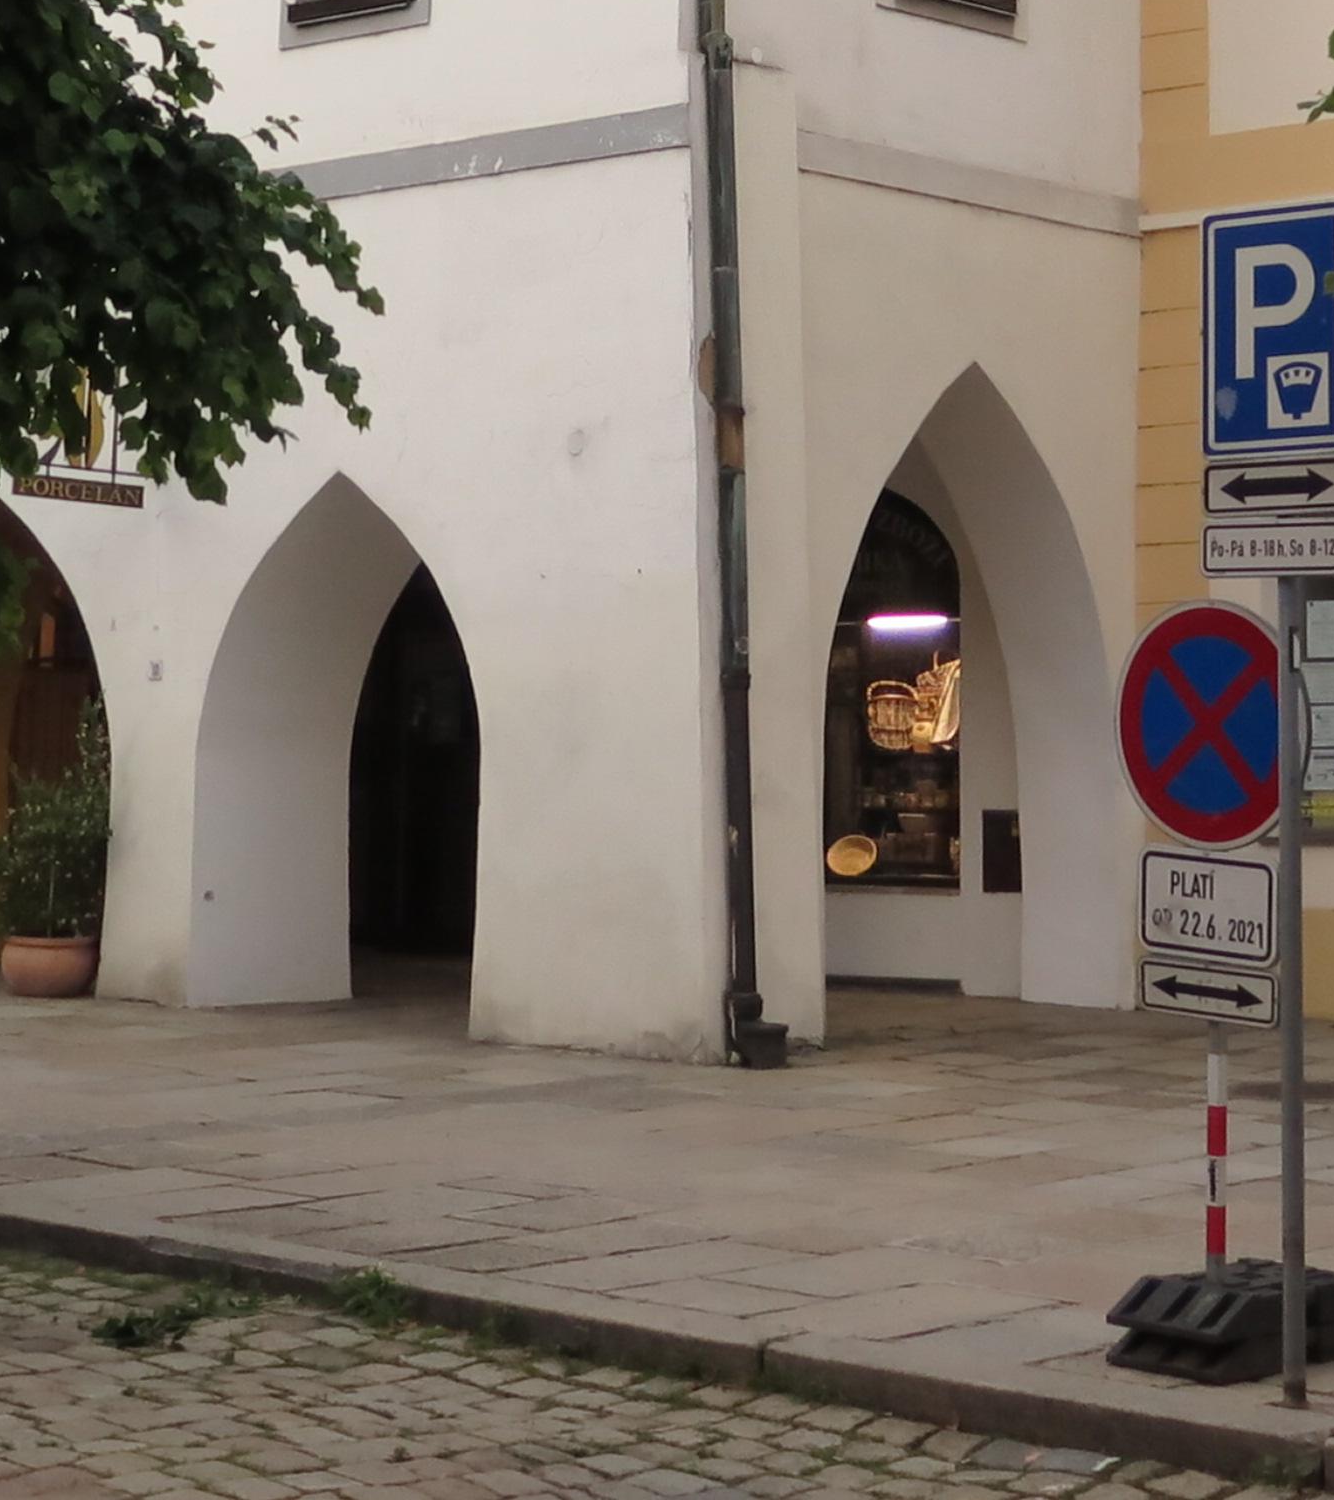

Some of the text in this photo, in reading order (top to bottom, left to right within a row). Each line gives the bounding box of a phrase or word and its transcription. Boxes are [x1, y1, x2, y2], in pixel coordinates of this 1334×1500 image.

[1234, 243, 1316, 380] P
[1170, 869, 1215, 900] PLATÍ
[1228, 918, 1264, 949] 2021
